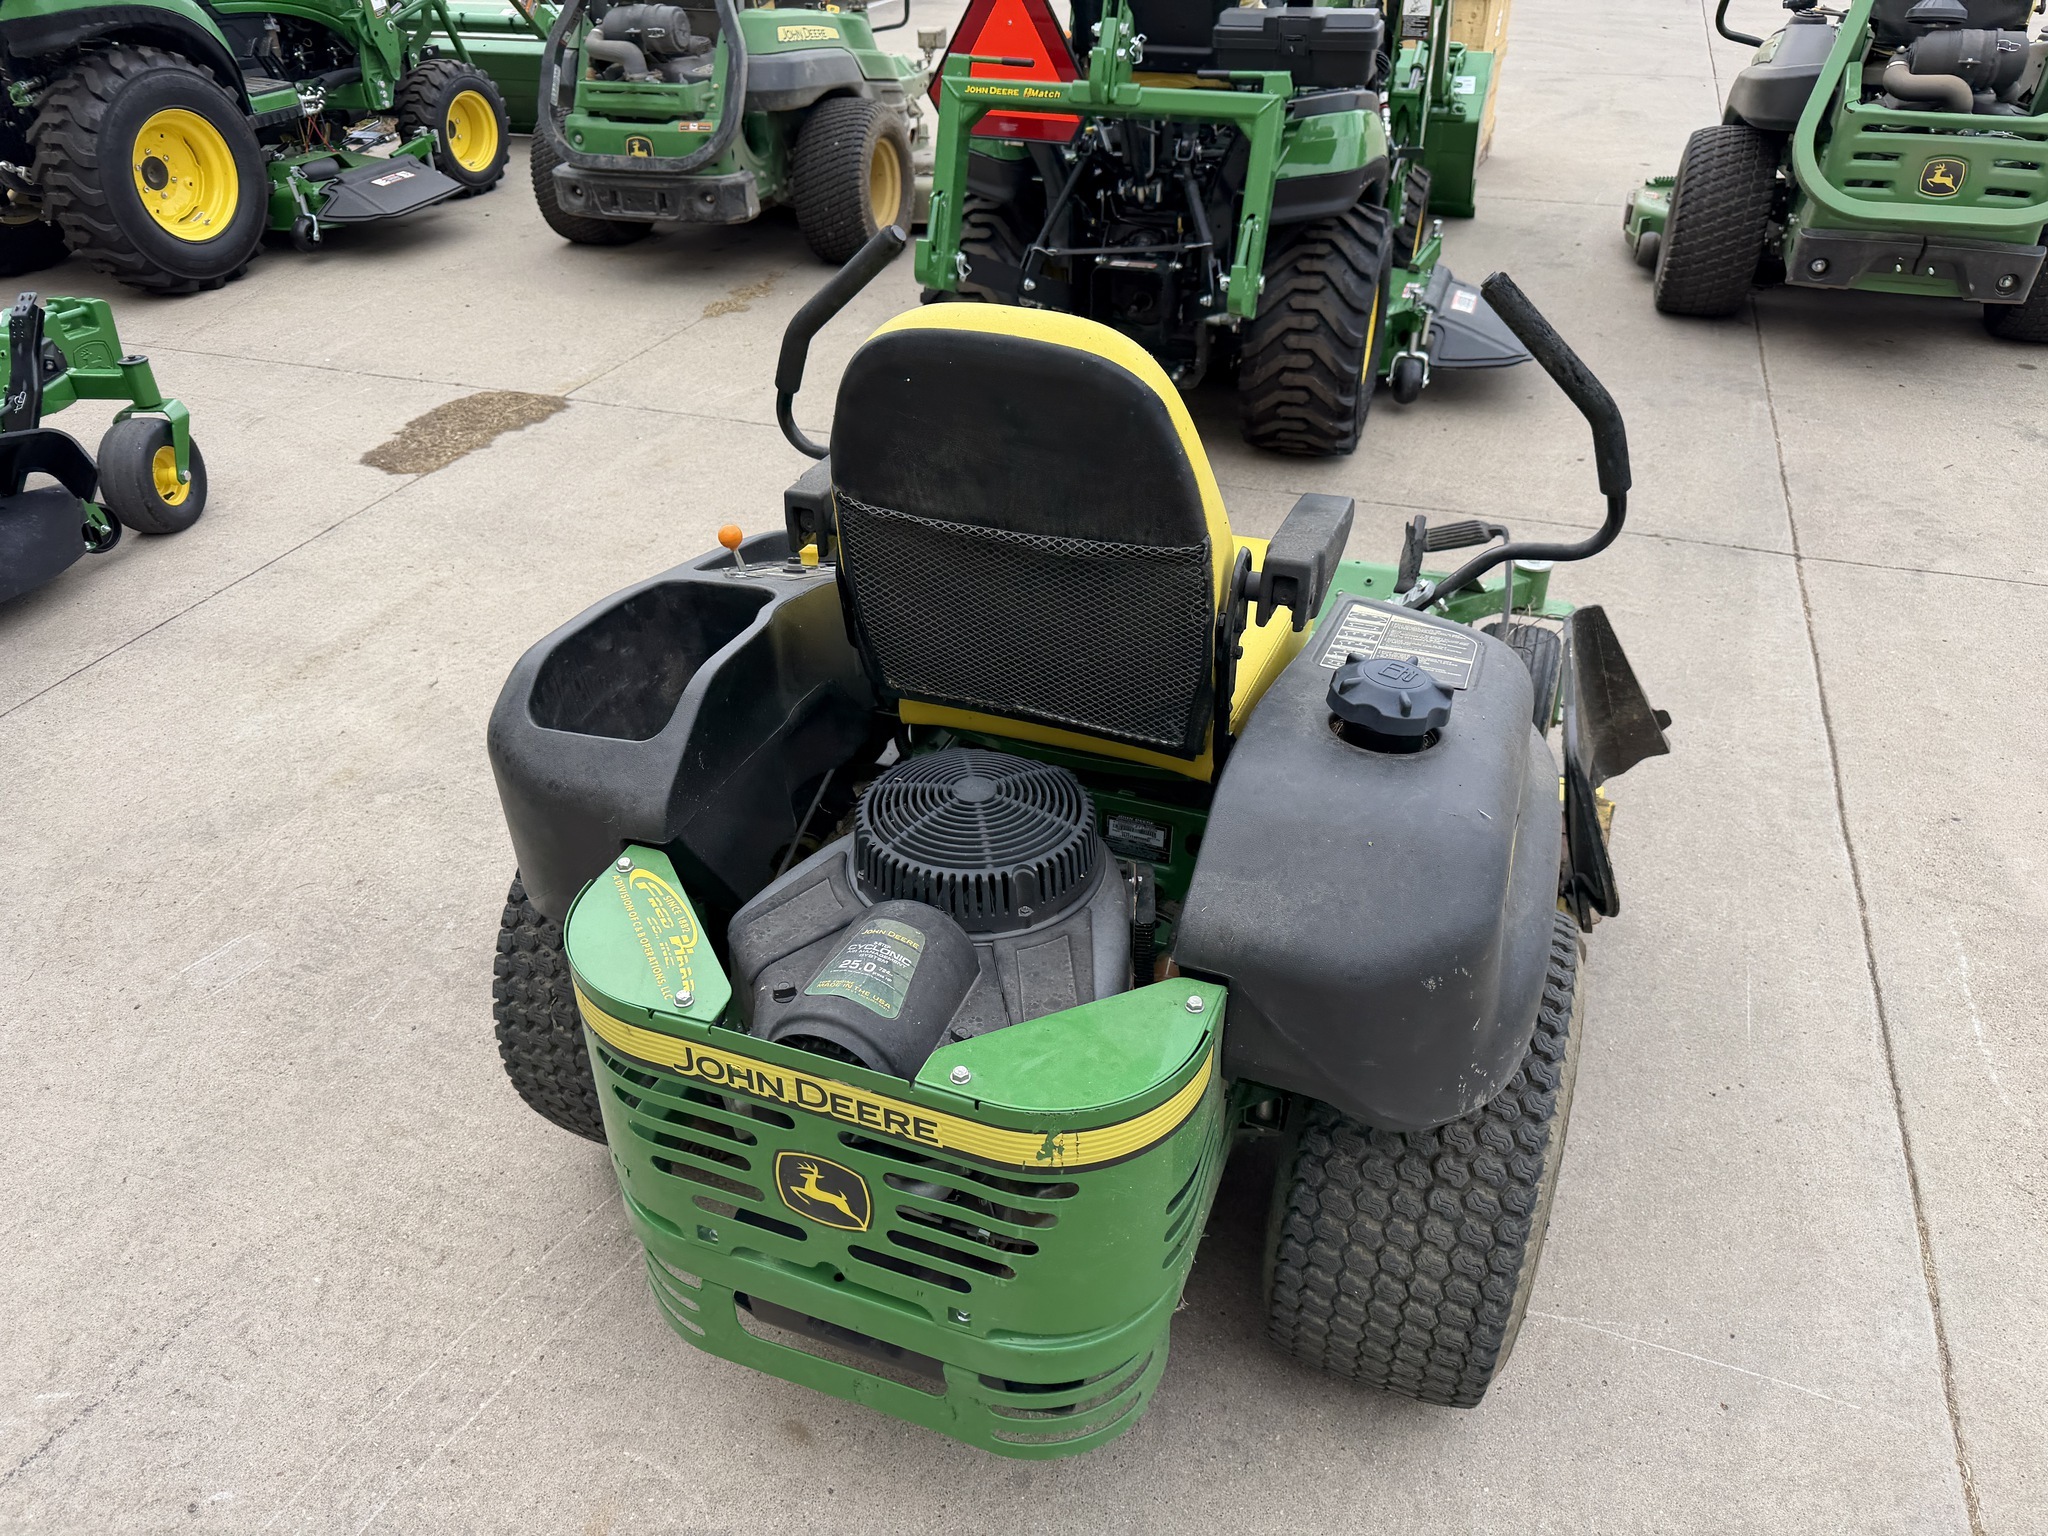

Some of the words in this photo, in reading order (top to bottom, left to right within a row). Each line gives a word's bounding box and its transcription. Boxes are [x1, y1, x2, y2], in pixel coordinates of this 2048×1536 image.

[782, 28, 804, 41] JOHN
[803, 27, 828, 39] DEERE
[964, 85, 988, 94] JOHN
[989, 86, 1019, 96] DEERE
[635, 881, 674, 929] FRED
[663, 895, 682, 916] SINCE
[677, 916, 691, 934] 1882
[614, 880, 634, 912] DIVISION
[630, 911, 640, 922] OF
[640, 937, 667, 987] OPERATIONS,
[660, 985, 674, 1000] LLC
[861, 928, 887, 936] JOHN
[888, 930, 919, 949] DEERE
[659, 942, 675, 969] INC.
[838, 959, 877, 973] 25.0
[848, 943, 912, 967] CYCLONIC
[858, 949, 908, 969] MANAGEMENT
[859, 953, 889, 965] SYSTEM
[854, 985, 871, 996] THE
[872, 994, 892, 1010] USA
[673, 1046, 785, 1101] JOHN
[795, 1077, 941, 1145] DEERE
